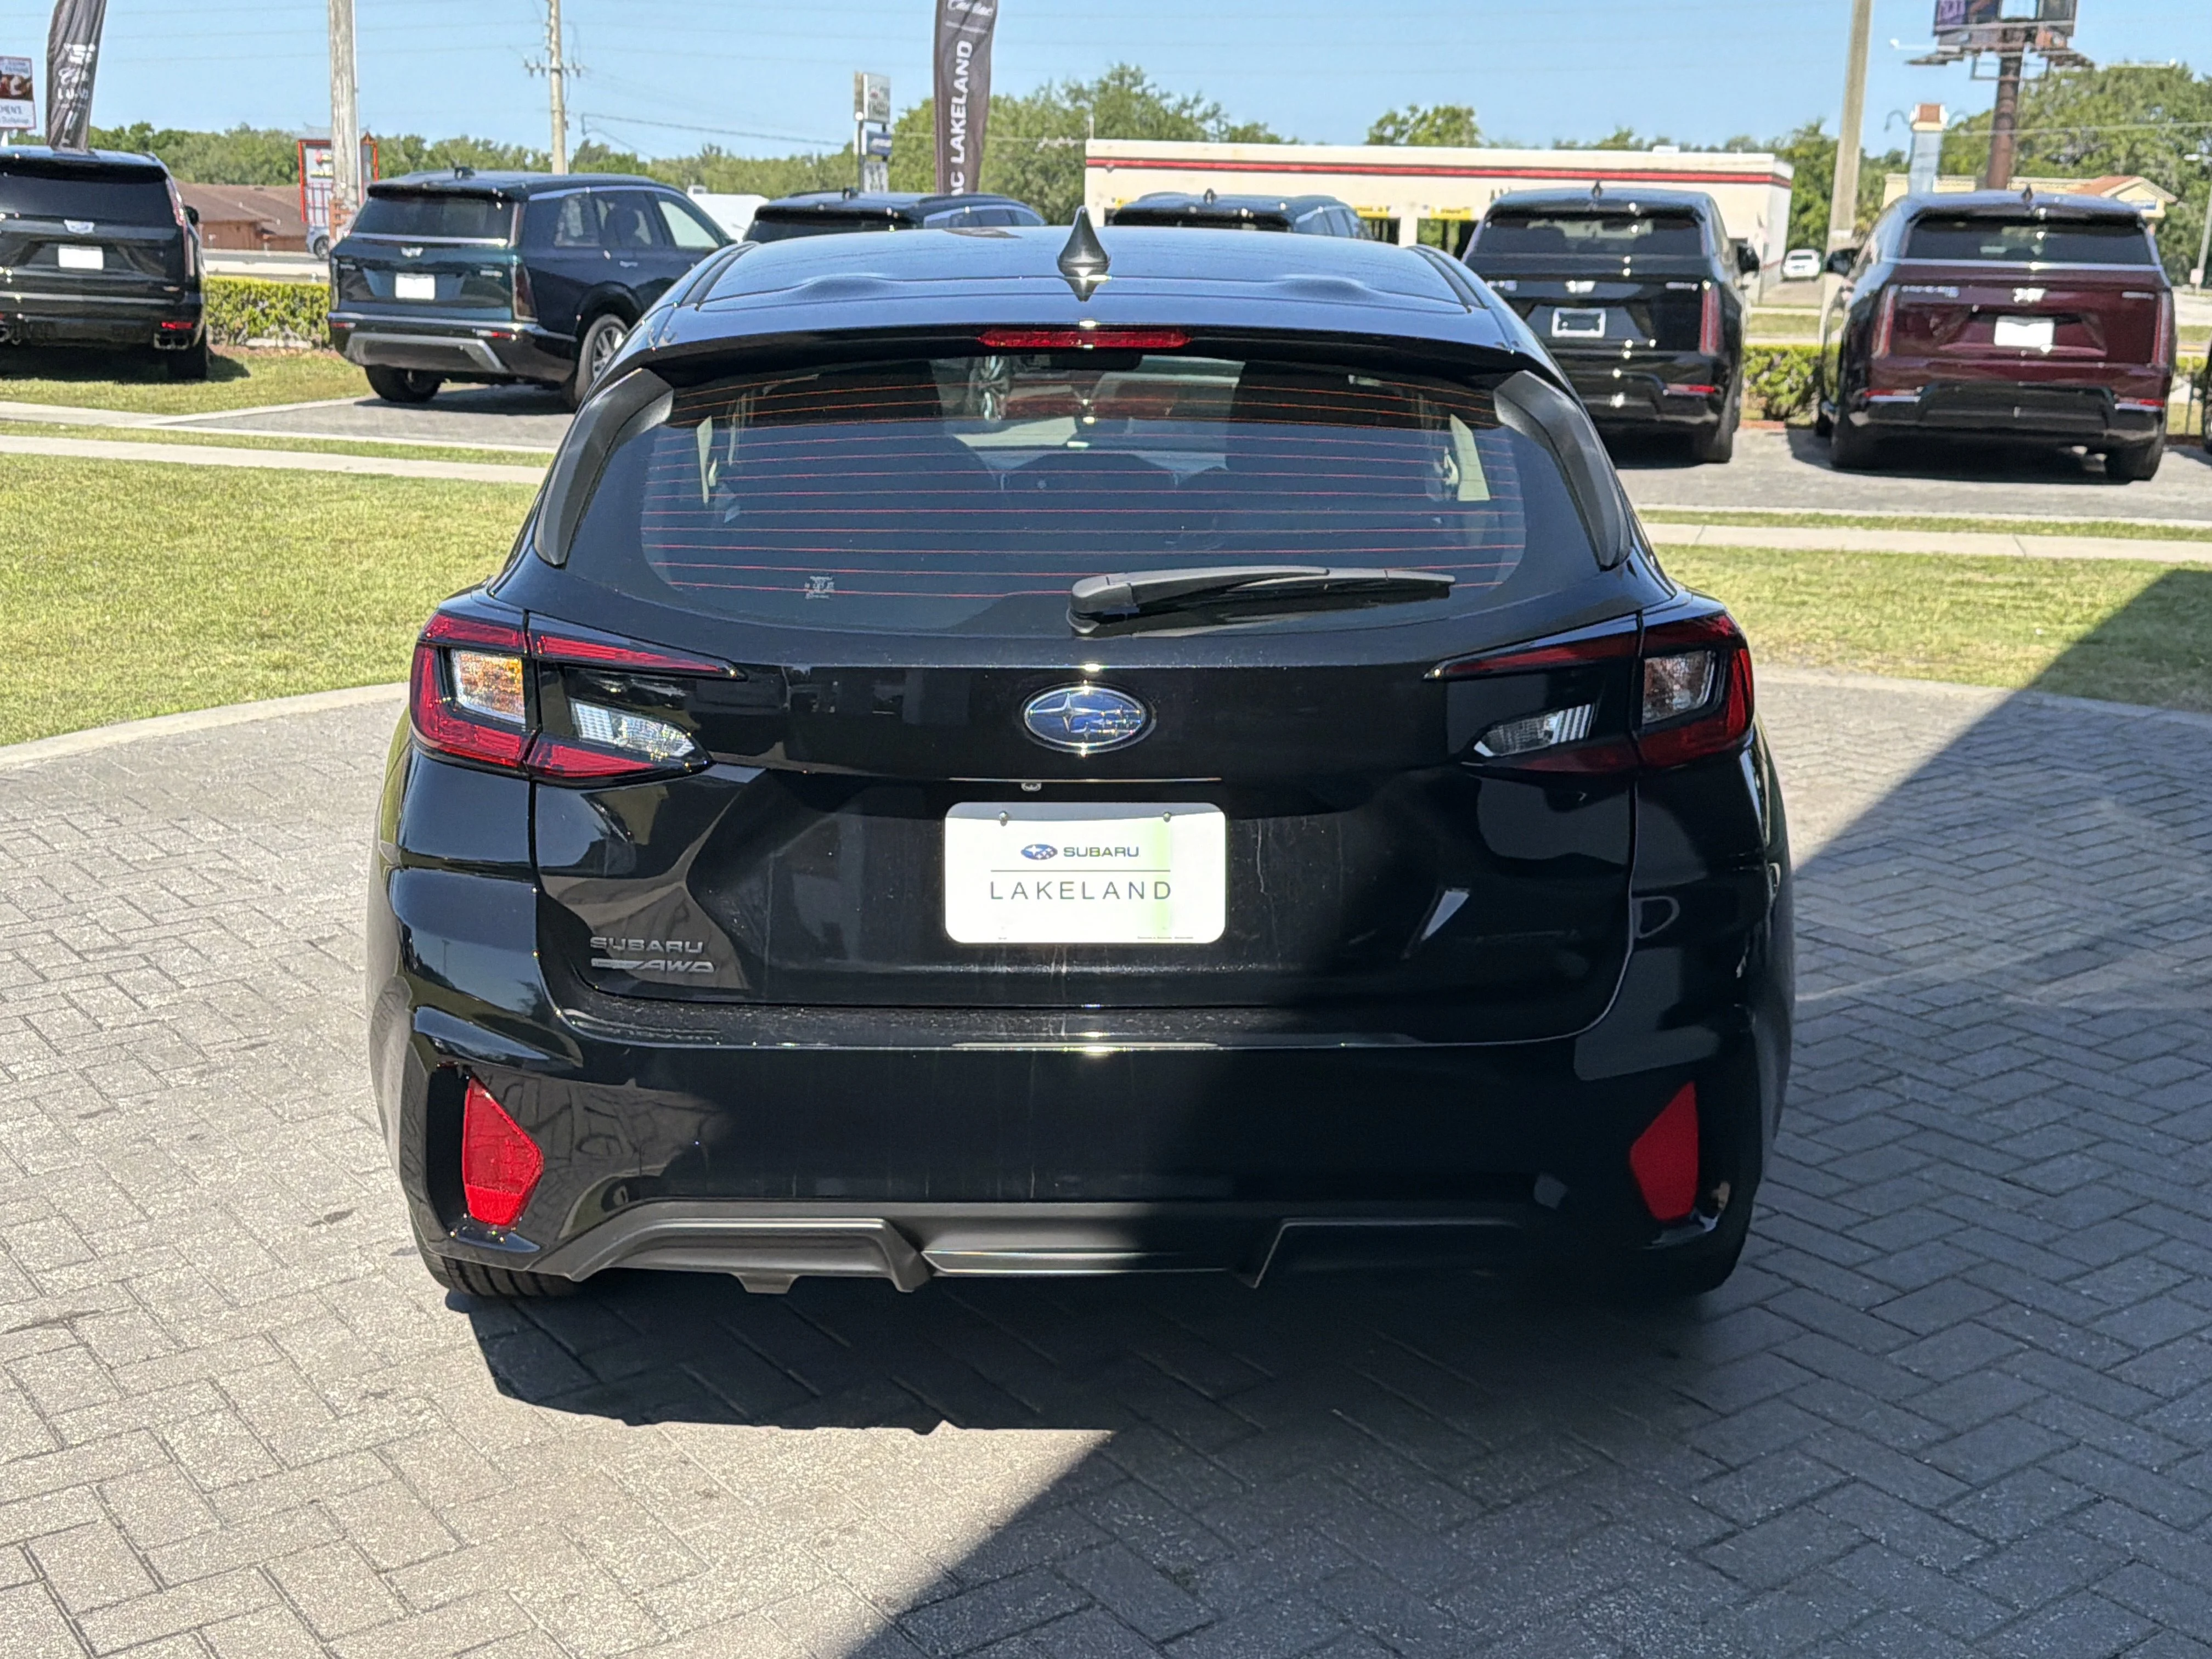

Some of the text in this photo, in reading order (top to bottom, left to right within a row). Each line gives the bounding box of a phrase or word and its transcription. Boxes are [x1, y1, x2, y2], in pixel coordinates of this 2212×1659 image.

[951, 40, 973, 164] LAKELAND
[1063, 847, 1139, 857] SUBARU
[990, 882, 1171, 900] LAKELAND
[590, 936, 703, 953] SUBARU
[637, 960, 714, 973] AWD
